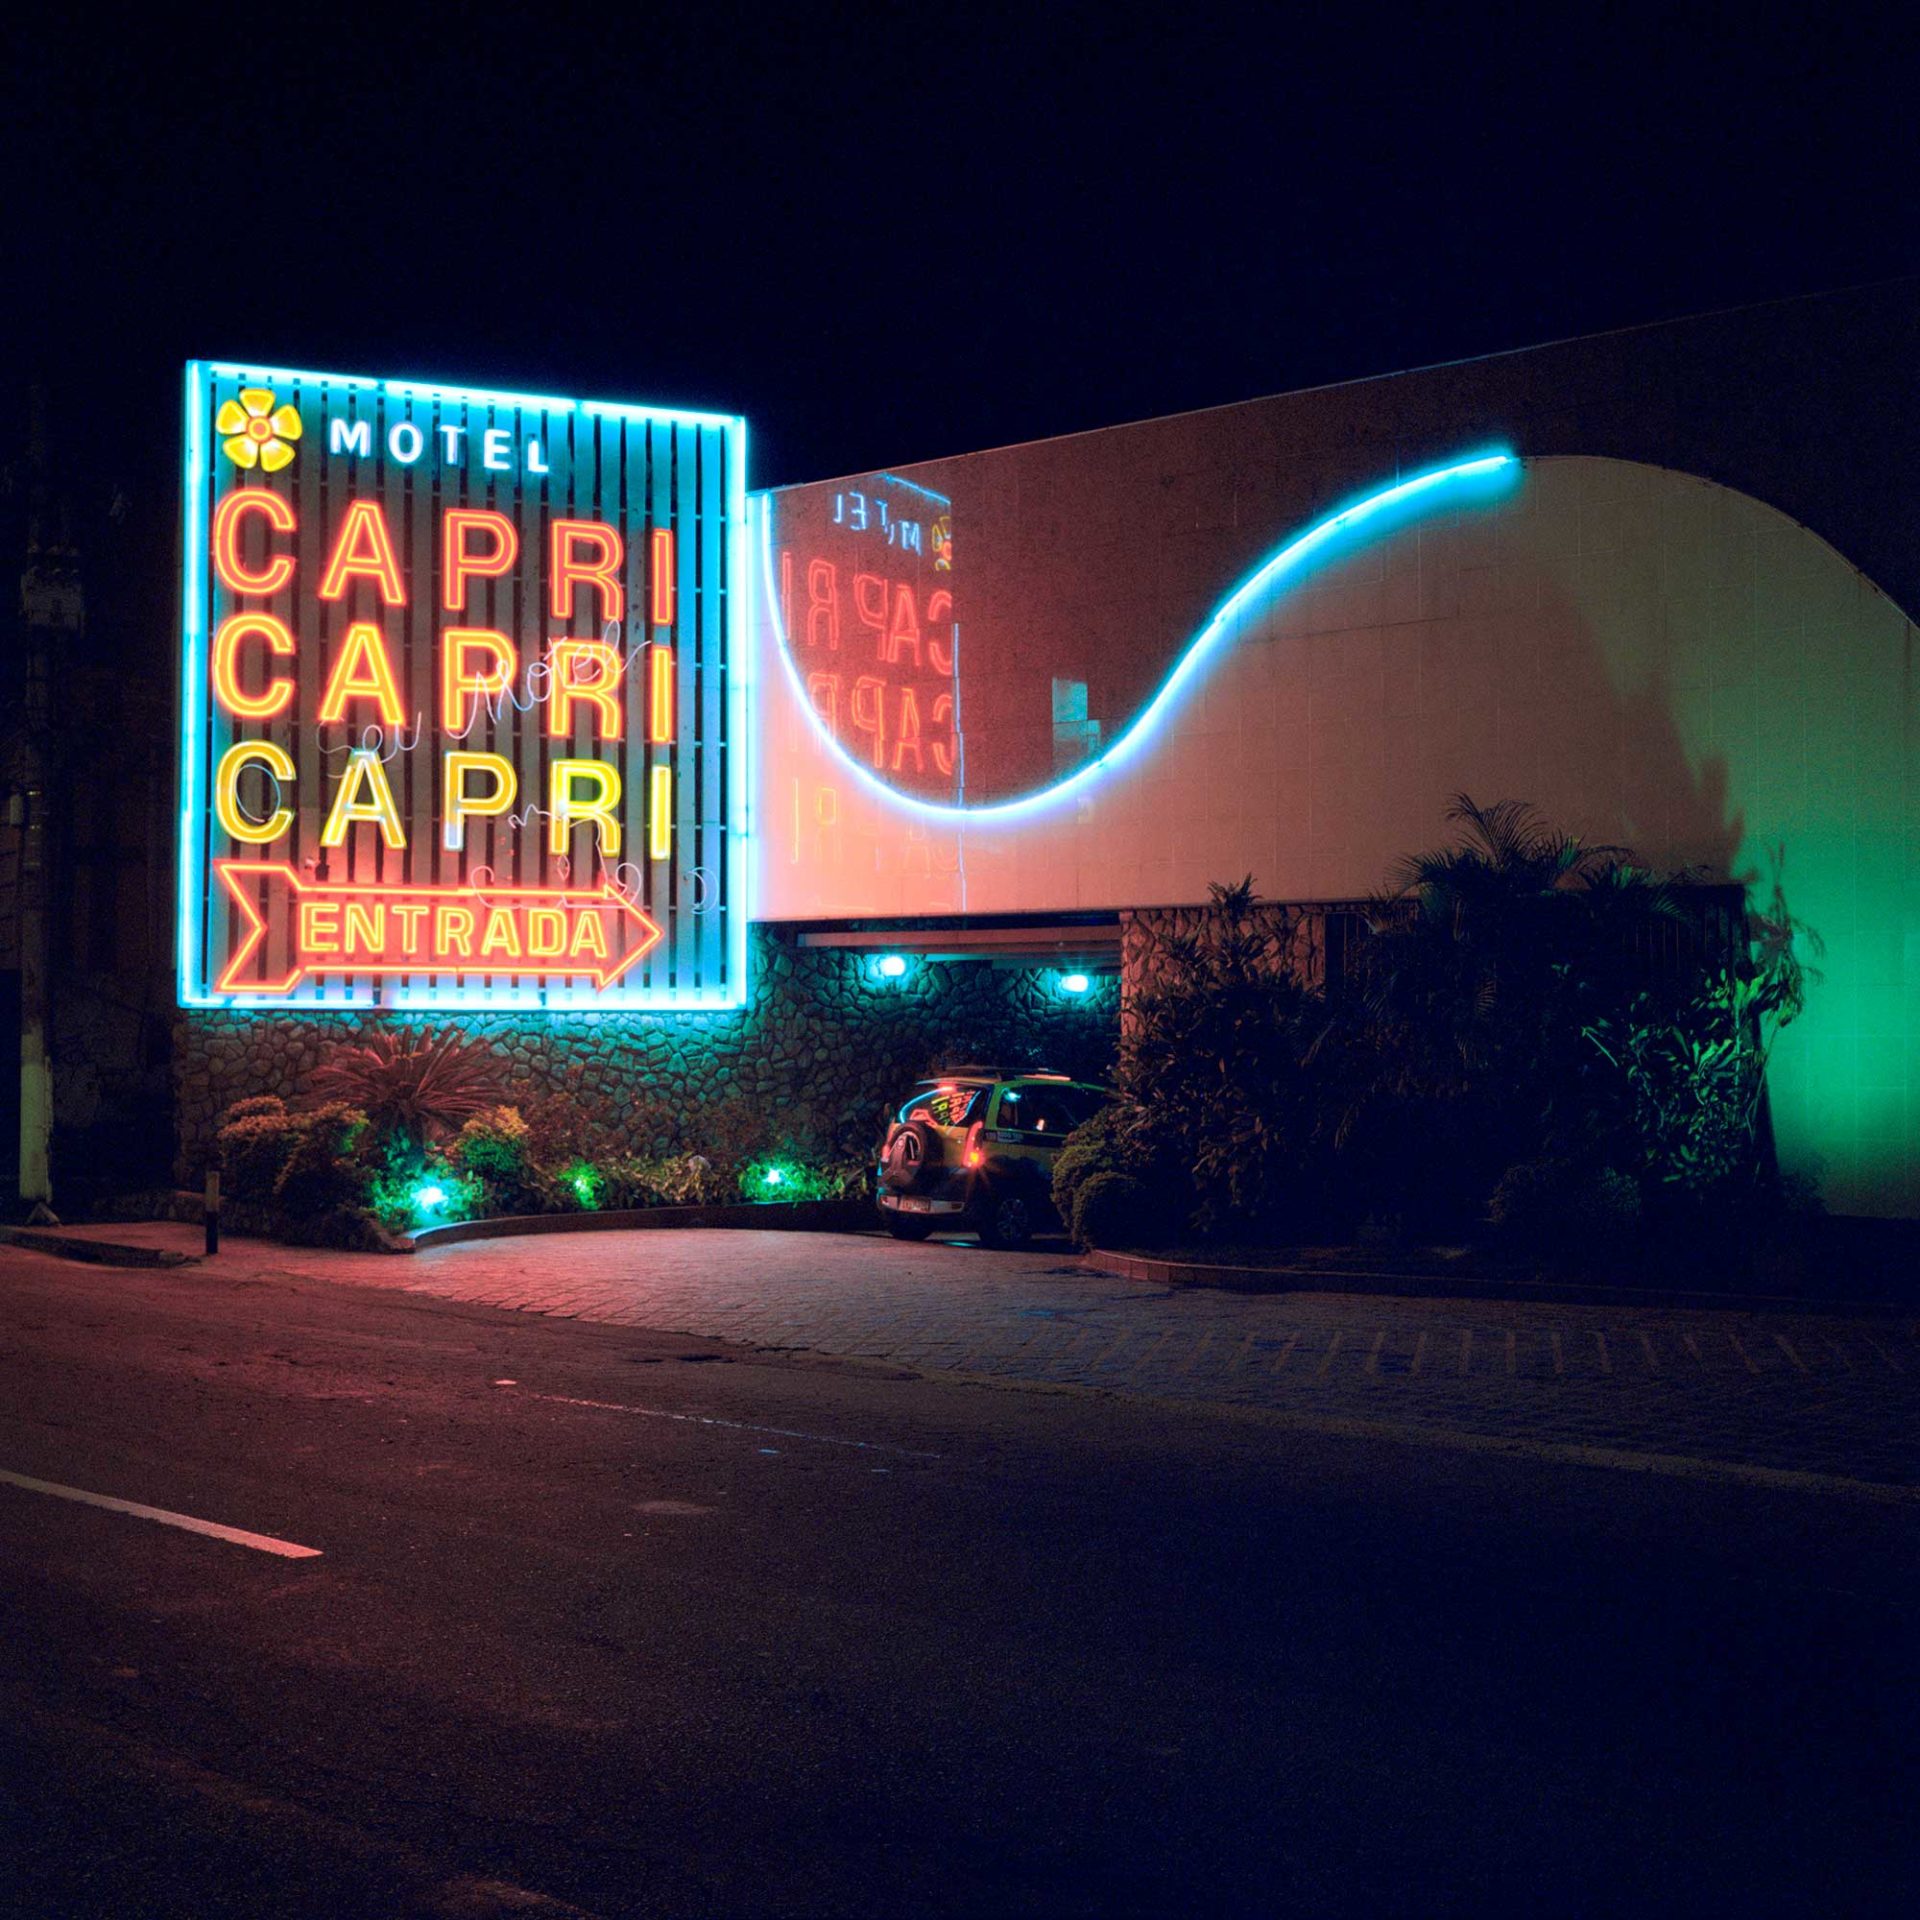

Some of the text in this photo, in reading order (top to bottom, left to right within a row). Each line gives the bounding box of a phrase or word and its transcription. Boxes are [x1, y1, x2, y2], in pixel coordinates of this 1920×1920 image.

[330, 418, 549, 473] MOTEL
[212, 488, 674, 626] CAPRI
[211, 611, 673, 745] CAPRI
[215, 740, 672, 861] CAPRI
[299, 902, 607, 958] ENTRADA
